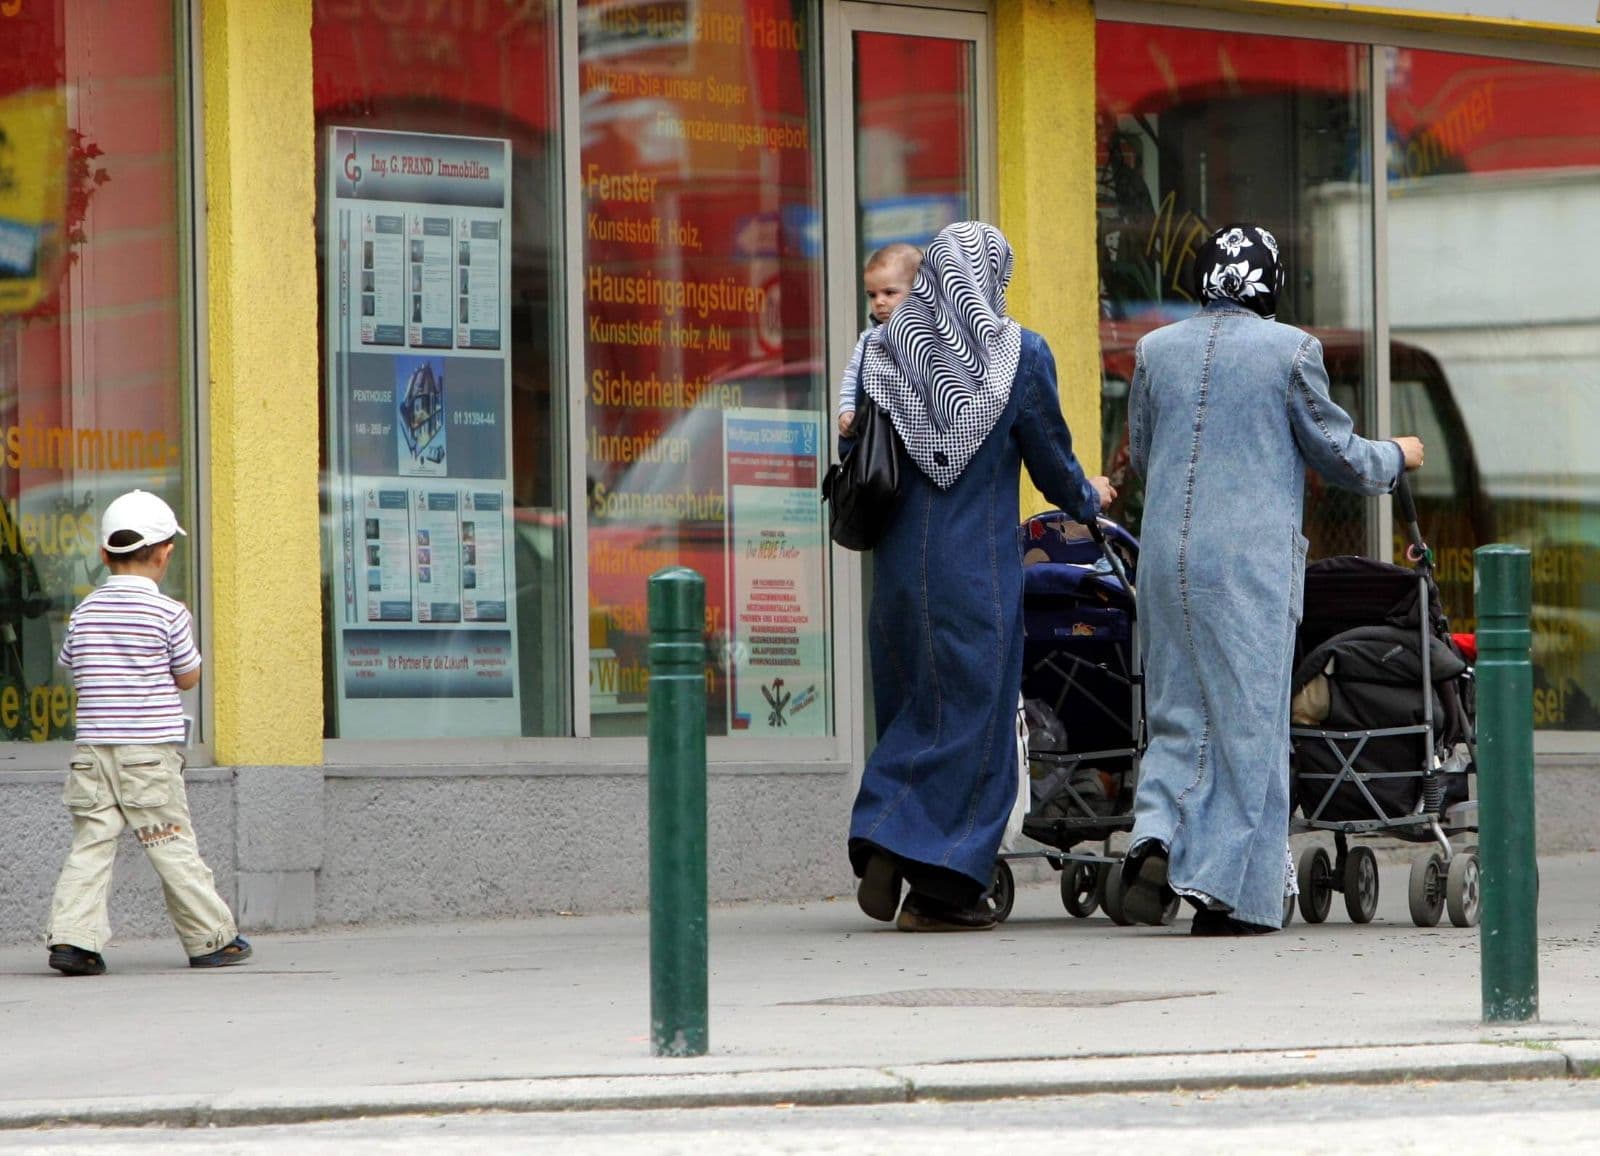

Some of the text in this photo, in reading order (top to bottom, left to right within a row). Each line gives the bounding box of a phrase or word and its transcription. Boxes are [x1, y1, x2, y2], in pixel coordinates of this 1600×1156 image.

[751, 9, 804, 50] Hand
[587, 64, 748, 109] Nutzen Sie unser Super
[656, 112, 807, 152] Finanzierungsangebot
[371, 153, 490, 180] Ing. G. PRAND Immobilien
[588, 164, 658, 203] Fenster
[668, 221, 703, 248] Holz,
[588, 266, 768, 318] Hauseingangstüren
[590, 316, 731, 352] Kunststoff, Holz, Alu
[353, 389, 392, 403] PENTHOUSE
[592, 369, 743, 411] Sicherheitstüren
[592, 431, 690, 464] Innentüren
[594, 484, 724, 522] Sonnenschutz
[0, 498, 95, 556] Neues
[595, 540, 679, 577] Markisen
[398, 656, 421, 670] Partner
[445, 656, 470, 670] Zukunft
